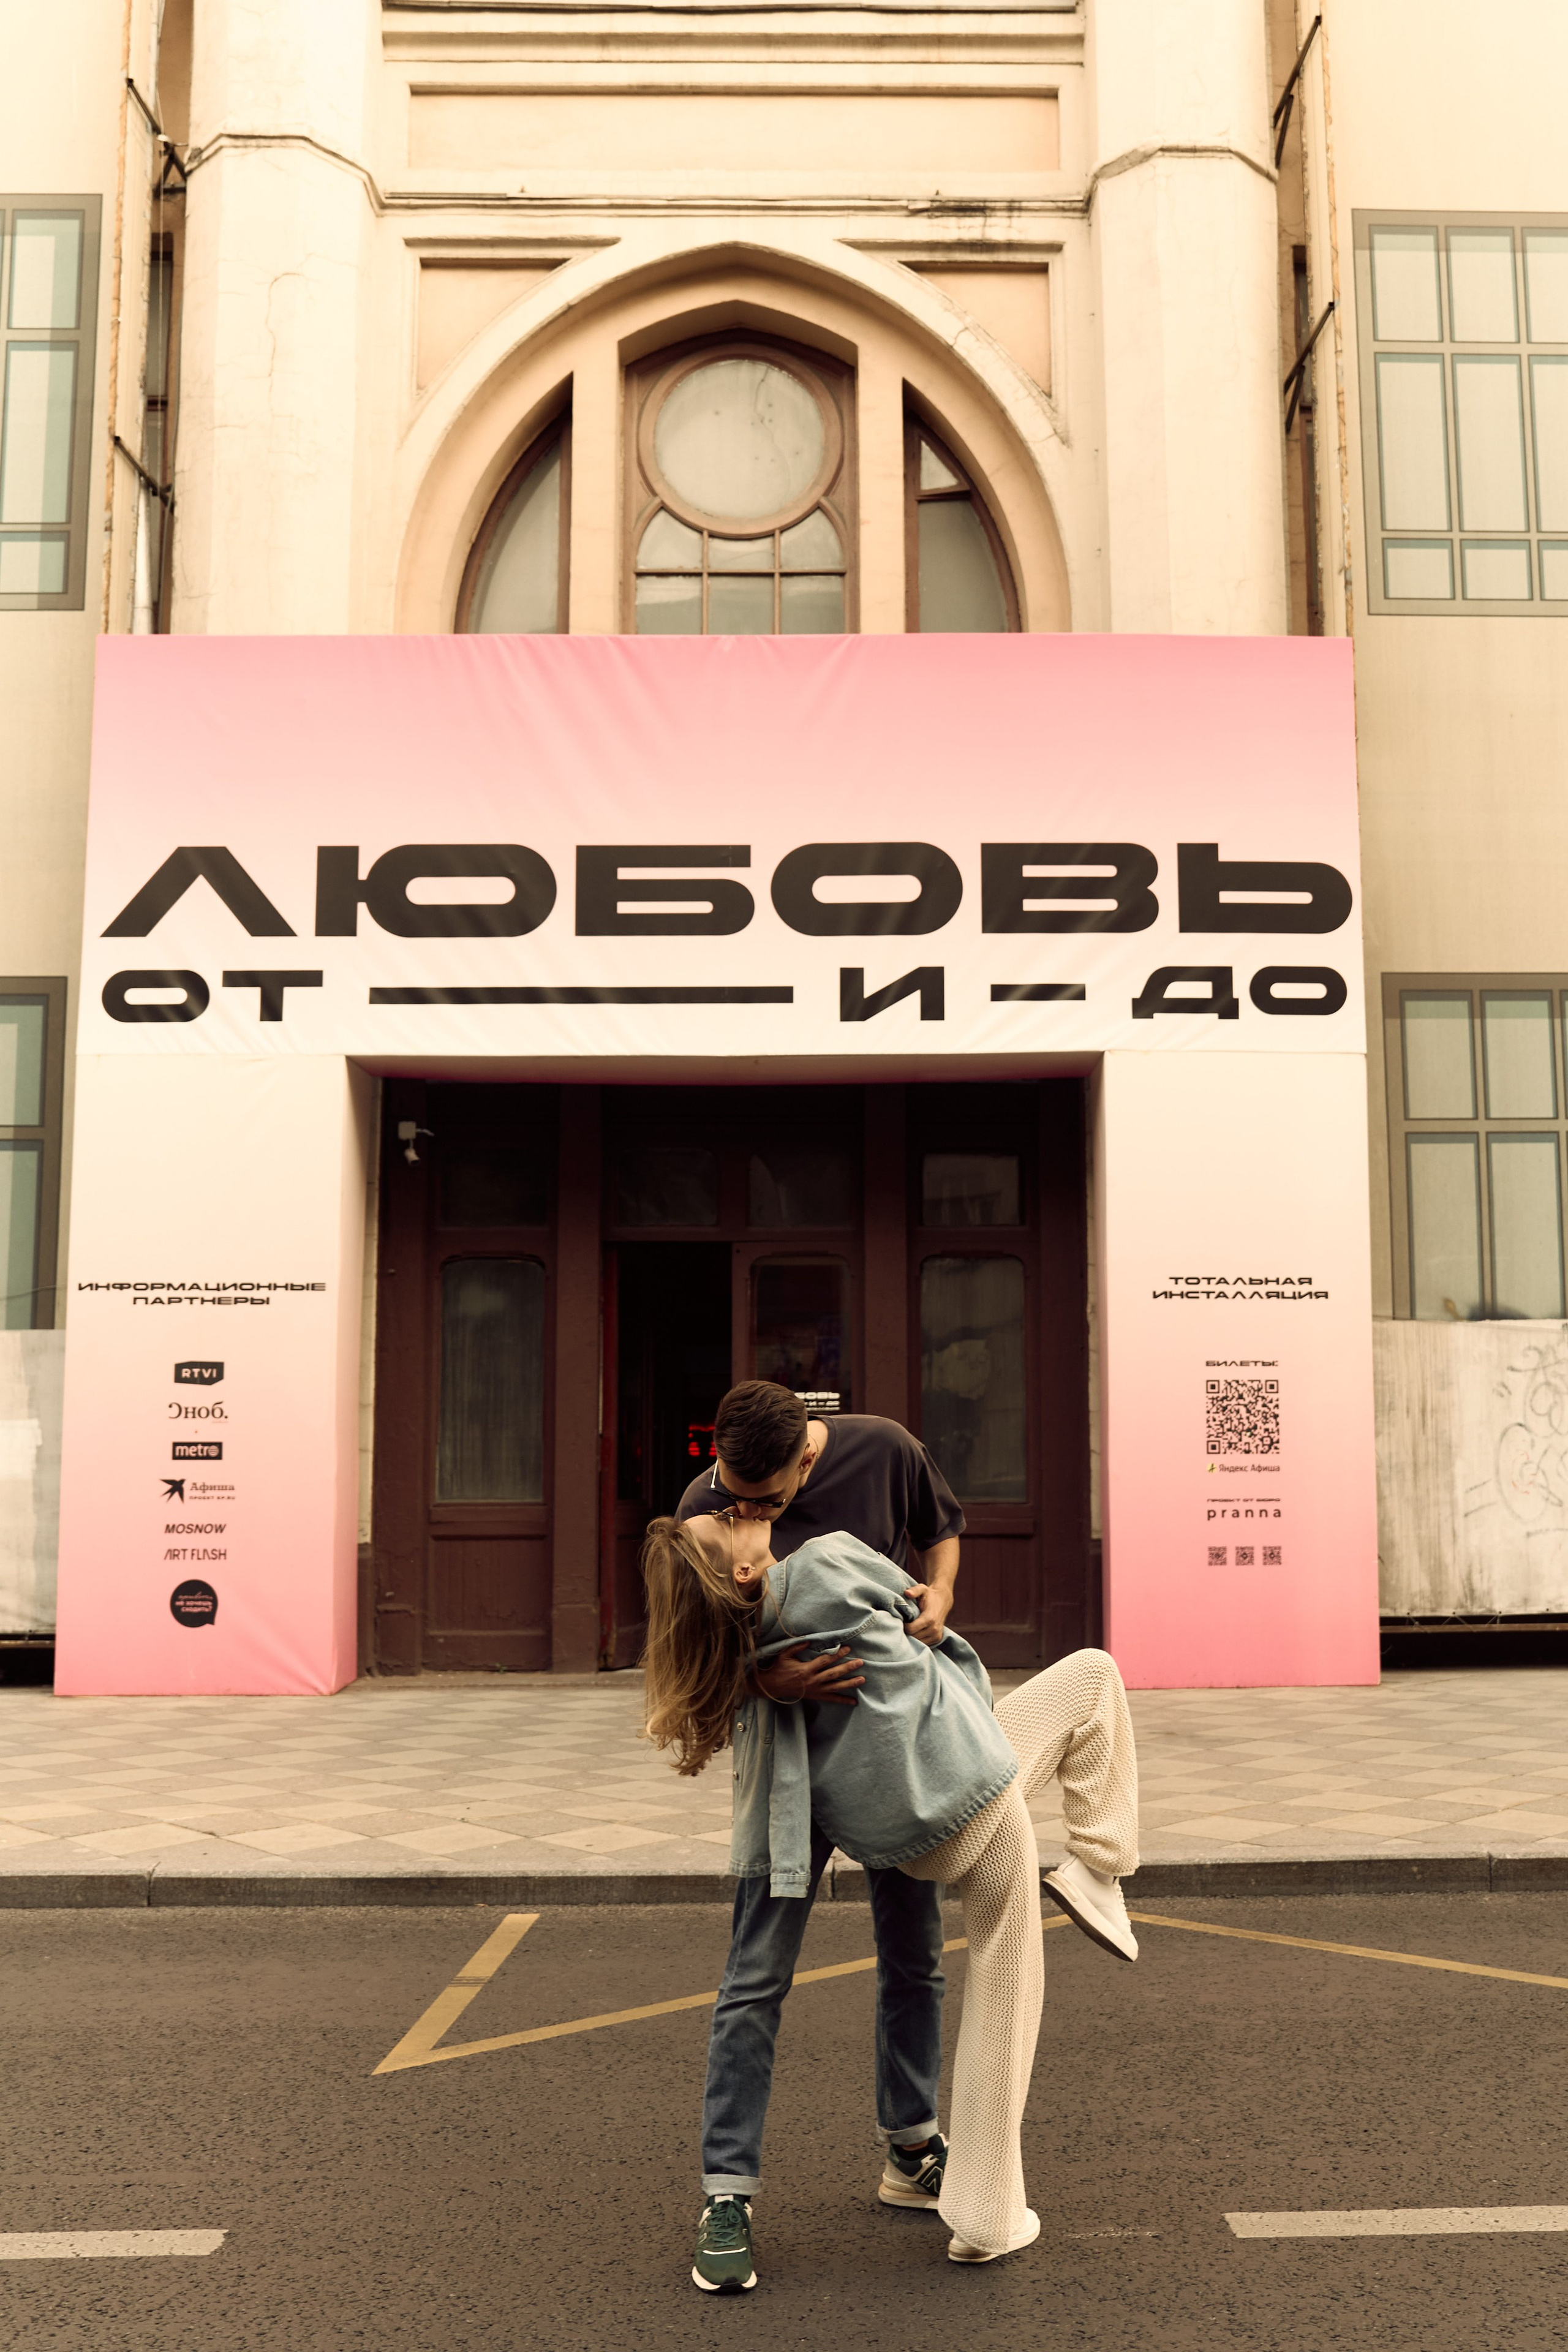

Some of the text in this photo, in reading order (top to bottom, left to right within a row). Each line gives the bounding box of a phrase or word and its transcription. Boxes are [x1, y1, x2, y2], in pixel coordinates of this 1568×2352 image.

[100, 842, 1353, 938] ЛЮБОВЬ
[101, 970, 323, 1023] ОТ
[840, 966, 944, 1022] И
[1131, 965, 1348, 1020] ДО
[1169, 1276, 1313, 1286] ТОТАЛЬНАЯ
[78, 1283, 326, 1291] ИНФОРМАЦИОННЫЕ
[133, 1297, 270, 1305] ПАРТНЕРЫ
[1152, 1291, 1329, 1300] ИНСТАЛЛЯЦИЯ
[181, 1368, 217, 1378] RTVI
[175, 1444, 219, 1457] metro
[1219, 1464, 1248, 1472] Яндекс
[1250, 1464, 1281, 1473] Афиша
[190, 1482, 235, 1493] Афиша
[1207, 1509, 1281, 1521] pranna
[164, 1523, 227, 1534] MOSNOW
[164, 1548, 227, 1561] ART FLASH
